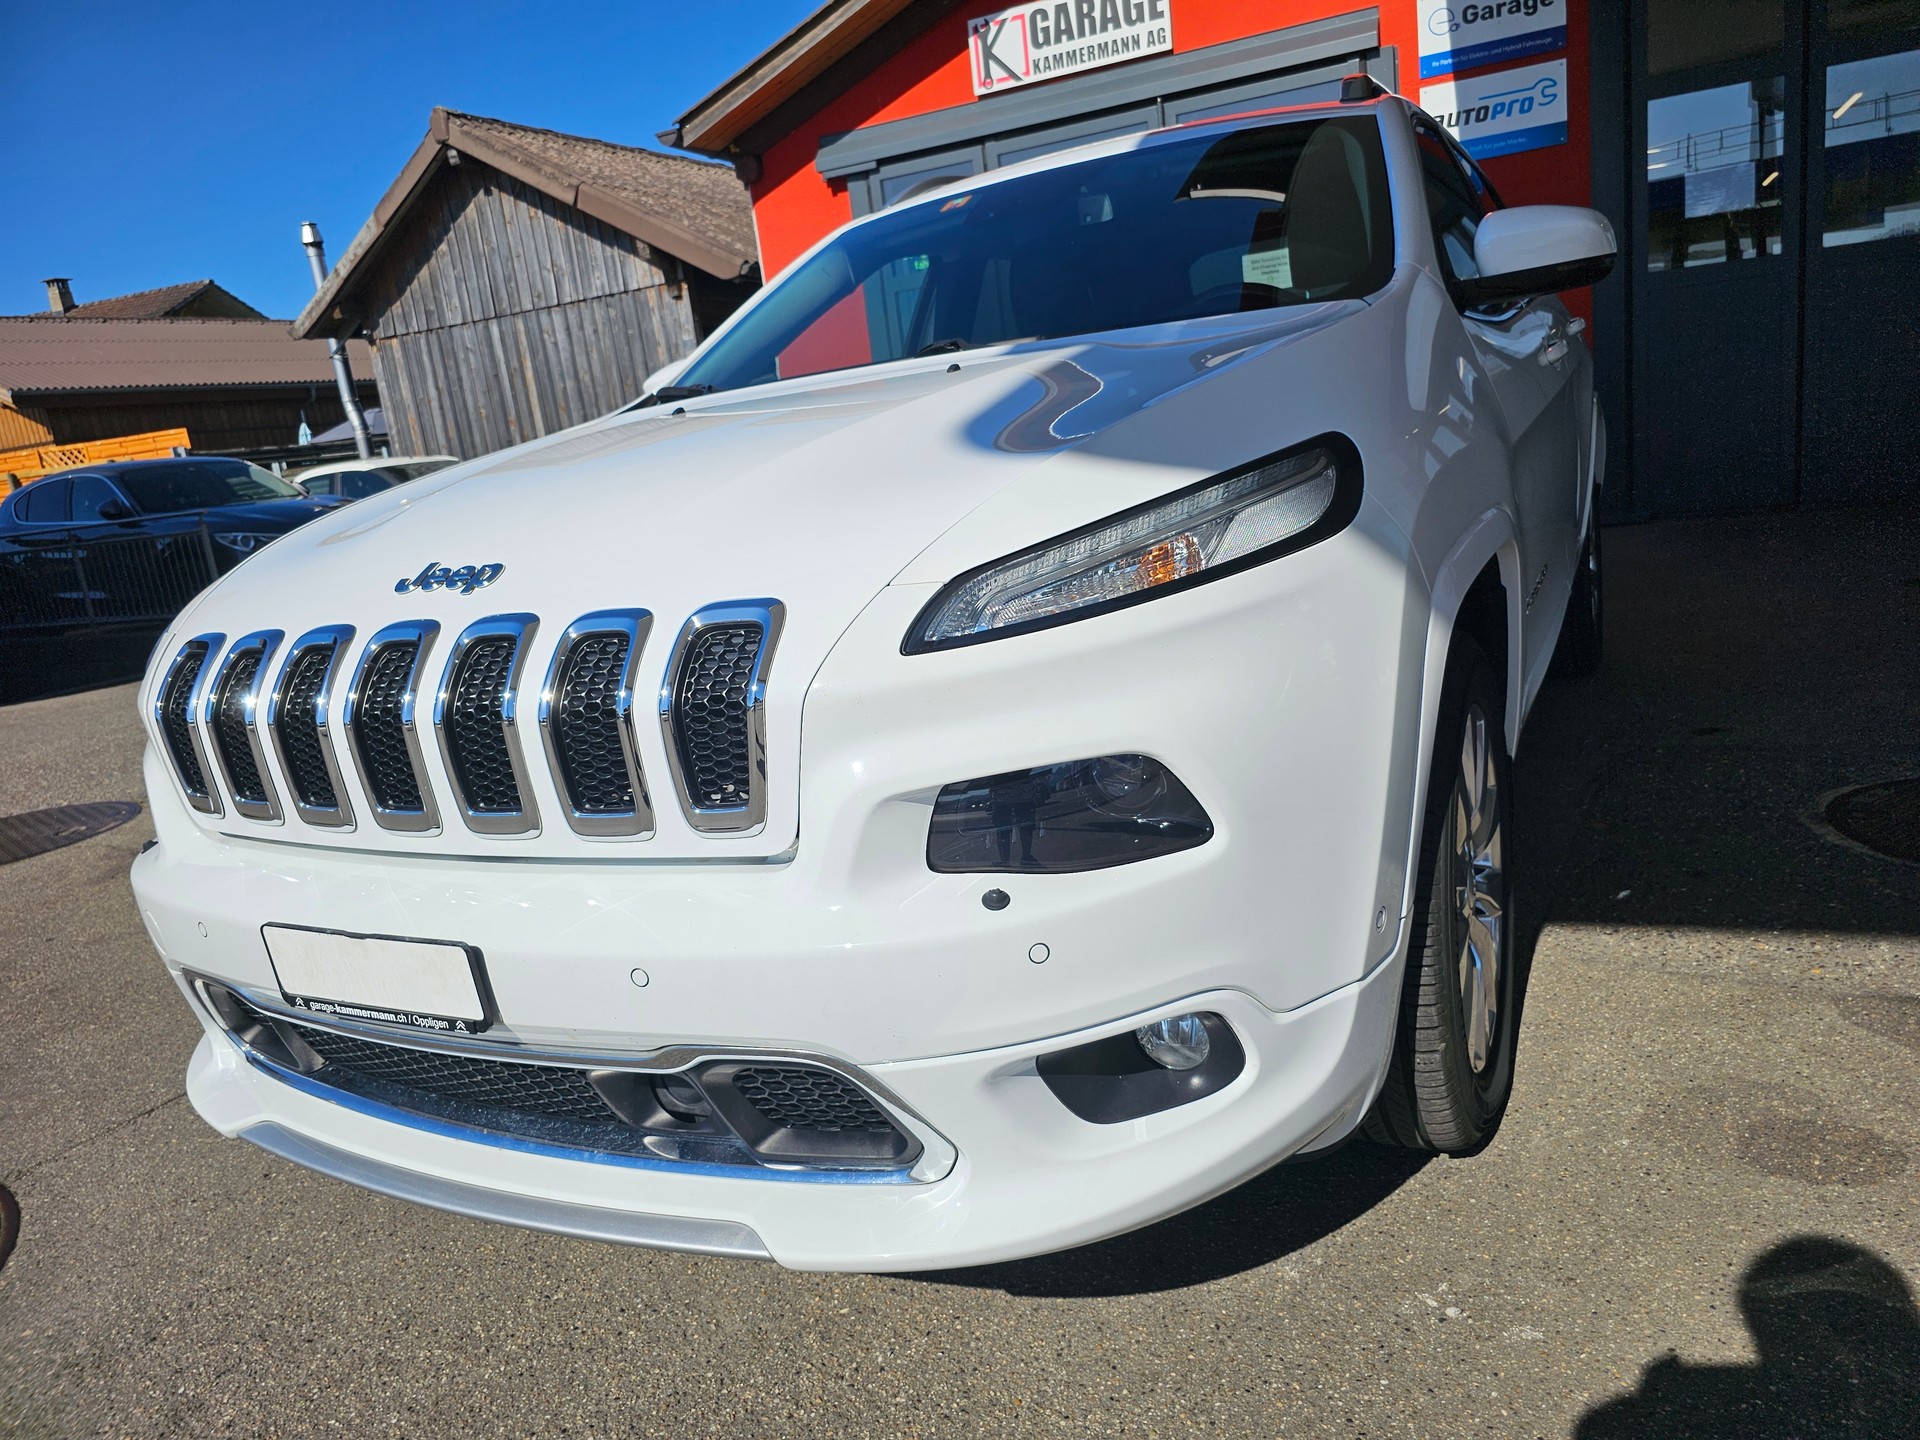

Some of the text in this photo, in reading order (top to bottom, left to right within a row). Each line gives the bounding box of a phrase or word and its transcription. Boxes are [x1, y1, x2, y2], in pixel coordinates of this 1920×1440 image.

[1032, 27, 1166, 75] KAMMERMANN AG
[394, 562, 506, 595] Jeep
[310, 1001, 407, 1024] garage-kammermann.ch
[412, 1014, 449, 1030] Oppligen
